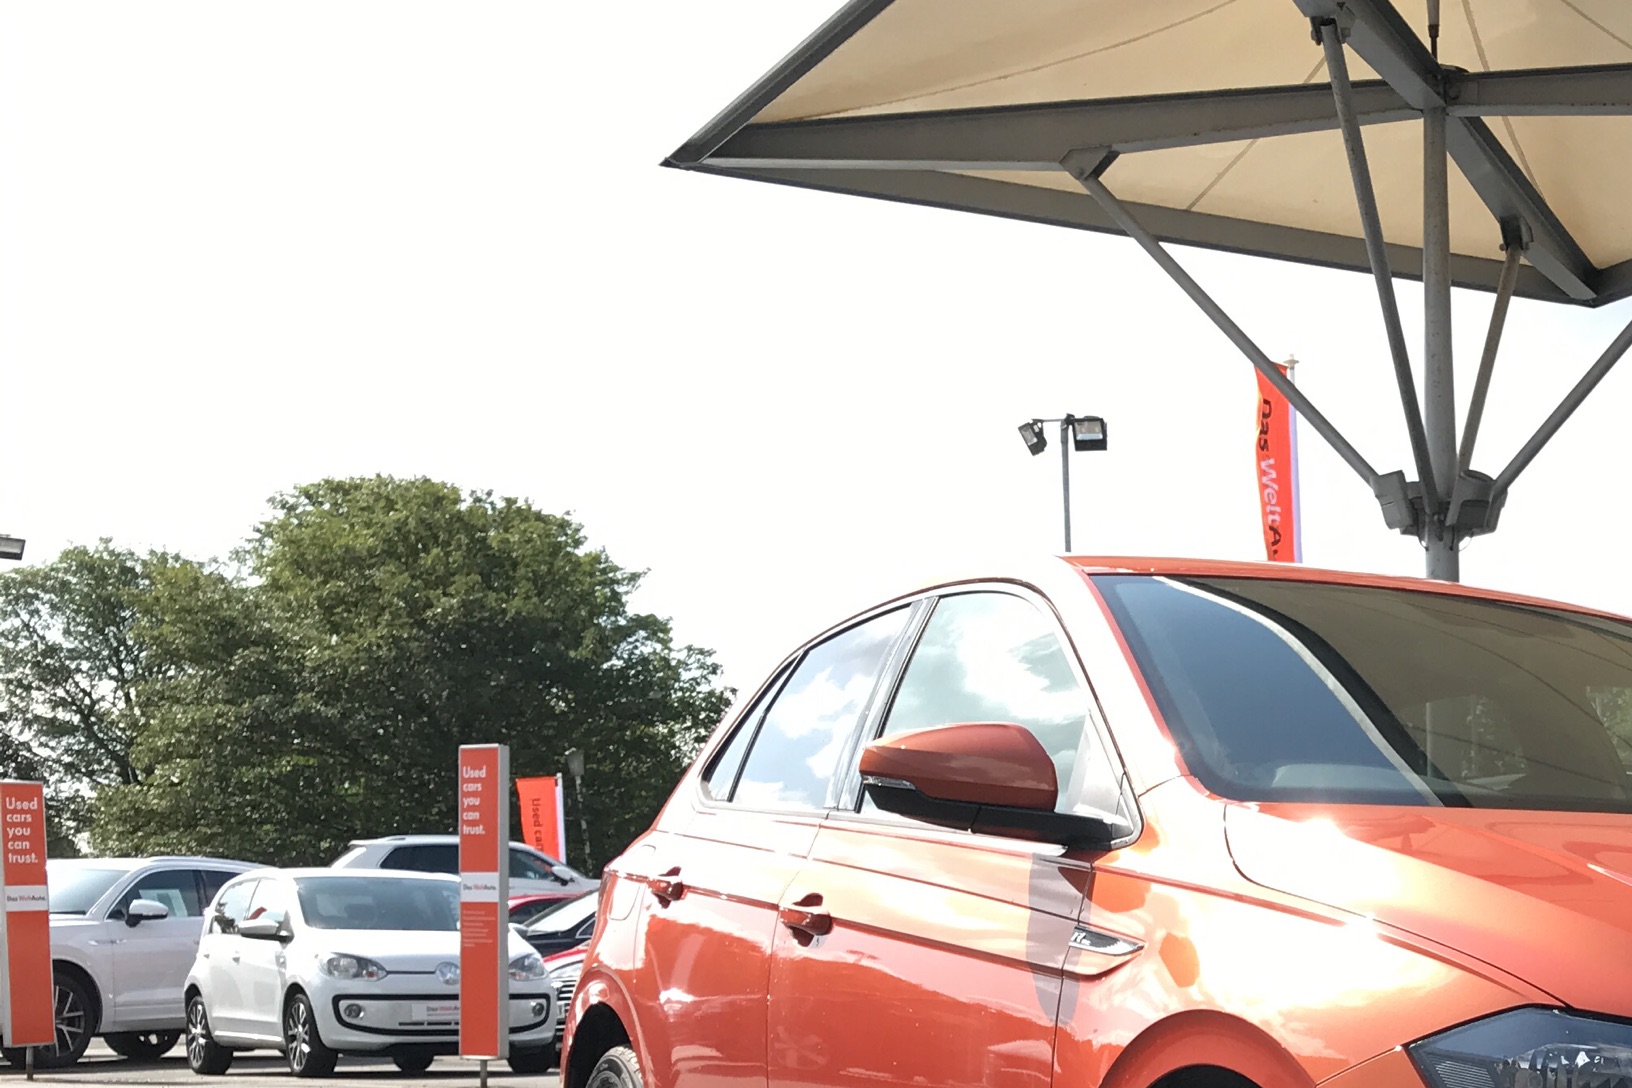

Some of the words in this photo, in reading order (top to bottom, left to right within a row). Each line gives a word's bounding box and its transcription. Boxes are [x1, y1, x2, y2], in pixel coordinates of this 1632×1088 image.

[462, 766, 486, 778] Used
[463, 782, 482, 792] cars
[6, 797, 38, 810] Used
[463, 797, 480, 808] you
[6, 813, 32, 822] cars
[463, 812, 480, 820] can
[532, 798, 543, 827] Used
[7, 827, 31, 838] you
[463, 825, 485, 835] trust.
[8, 841, 30, 850] can
[8, 853, 39, 863] trust.
